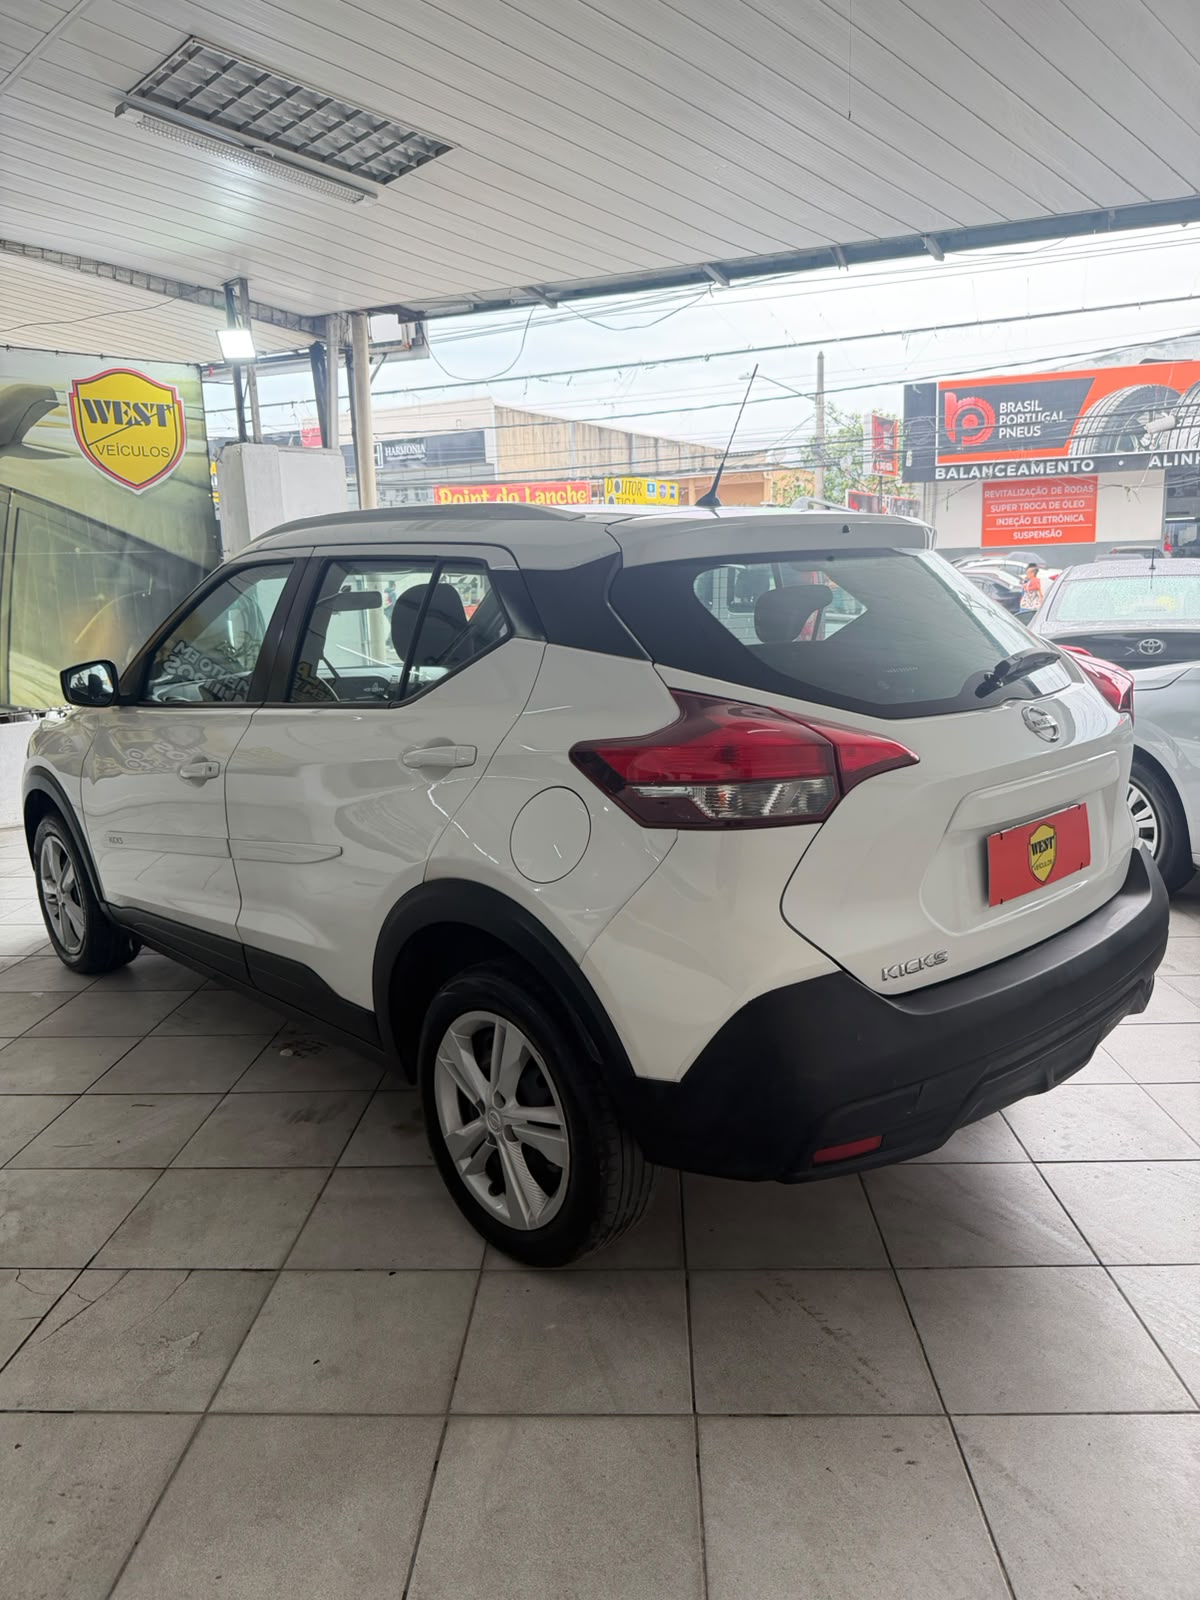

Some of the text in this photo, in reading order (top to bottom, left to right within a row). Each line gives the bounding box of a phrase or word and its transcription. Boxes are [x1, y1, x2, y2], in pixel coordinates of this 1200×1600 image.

[81, 398, 173, 428] WEST
[999, 399, 1043, 414] BRASIL
[999, 411, 1066, 425] PORTUGAL
[998, 425, 1042, 439] PNEUS
[95, 442, 170, 458] VEÍCULOS
[384, 443, 427, 457] HARMONIA
[934, 460, 1095, 480] BALANCEAMENTO
[438, 484, 587, 504] Point do Lanche
[984, 484, 1094, 498] REVITALIZAÇÃO DE RODAS
[990, 499, 1085, 513] SUPER TROCA DE ÓLEO
[996, 513, 1085, 527] INJEÇÃO ELETRÔNICA
[1012, 528, 1063, 540] SUSPENSÃO
[881, 949, 949, 982] KICKS
